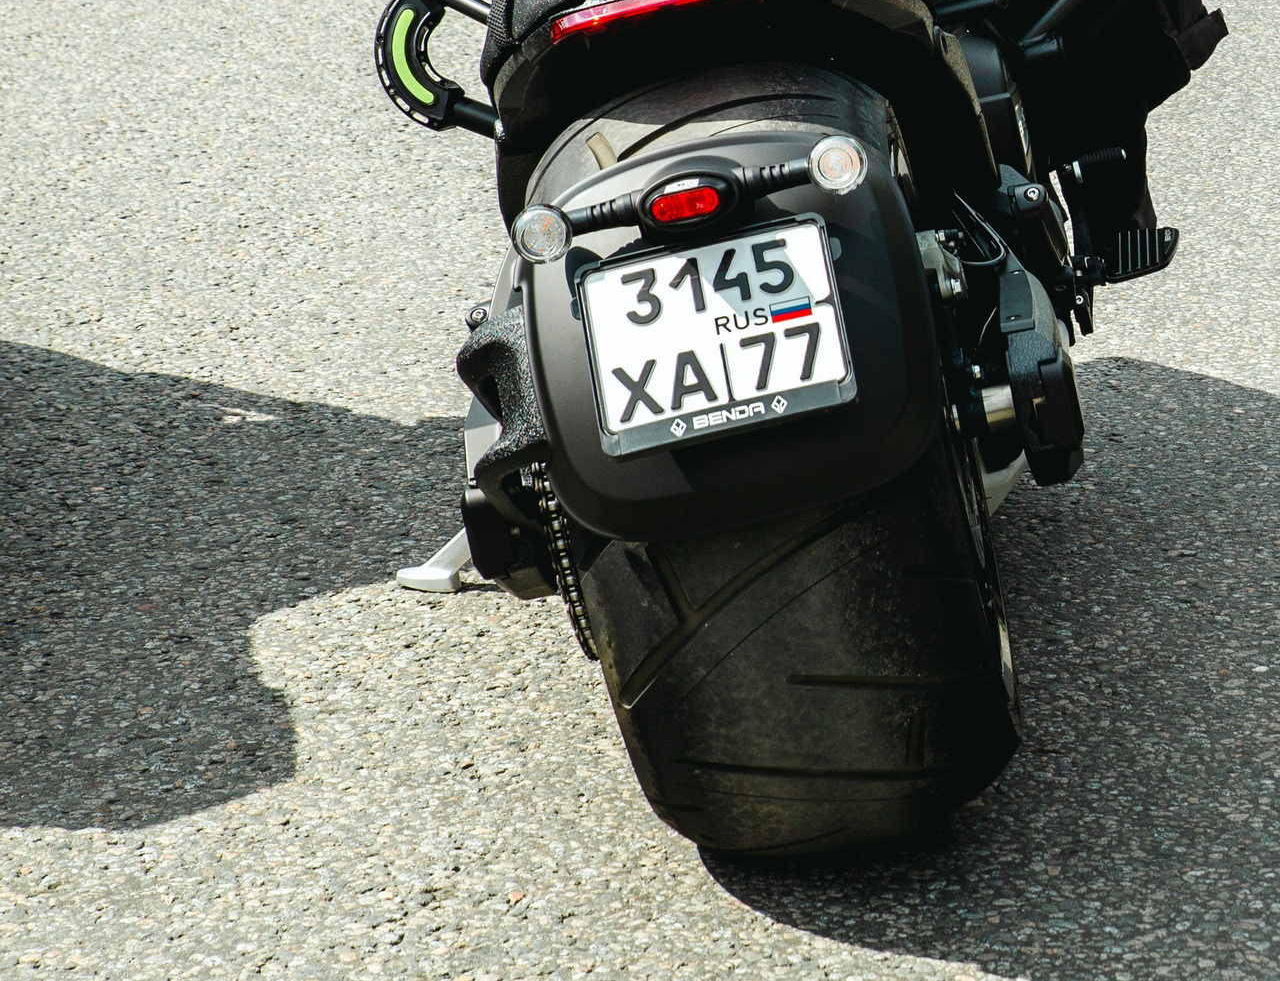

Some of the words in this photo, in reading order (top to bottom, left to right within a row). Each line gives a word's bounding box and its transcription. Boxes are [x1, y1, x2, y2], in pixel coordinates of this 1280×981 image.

[620, 238, 795, 325] 3145
[713, 307, 769, 336] RUS
[739, 321, 822, 392] 77
[692, 401, 766, 431] BENDA
